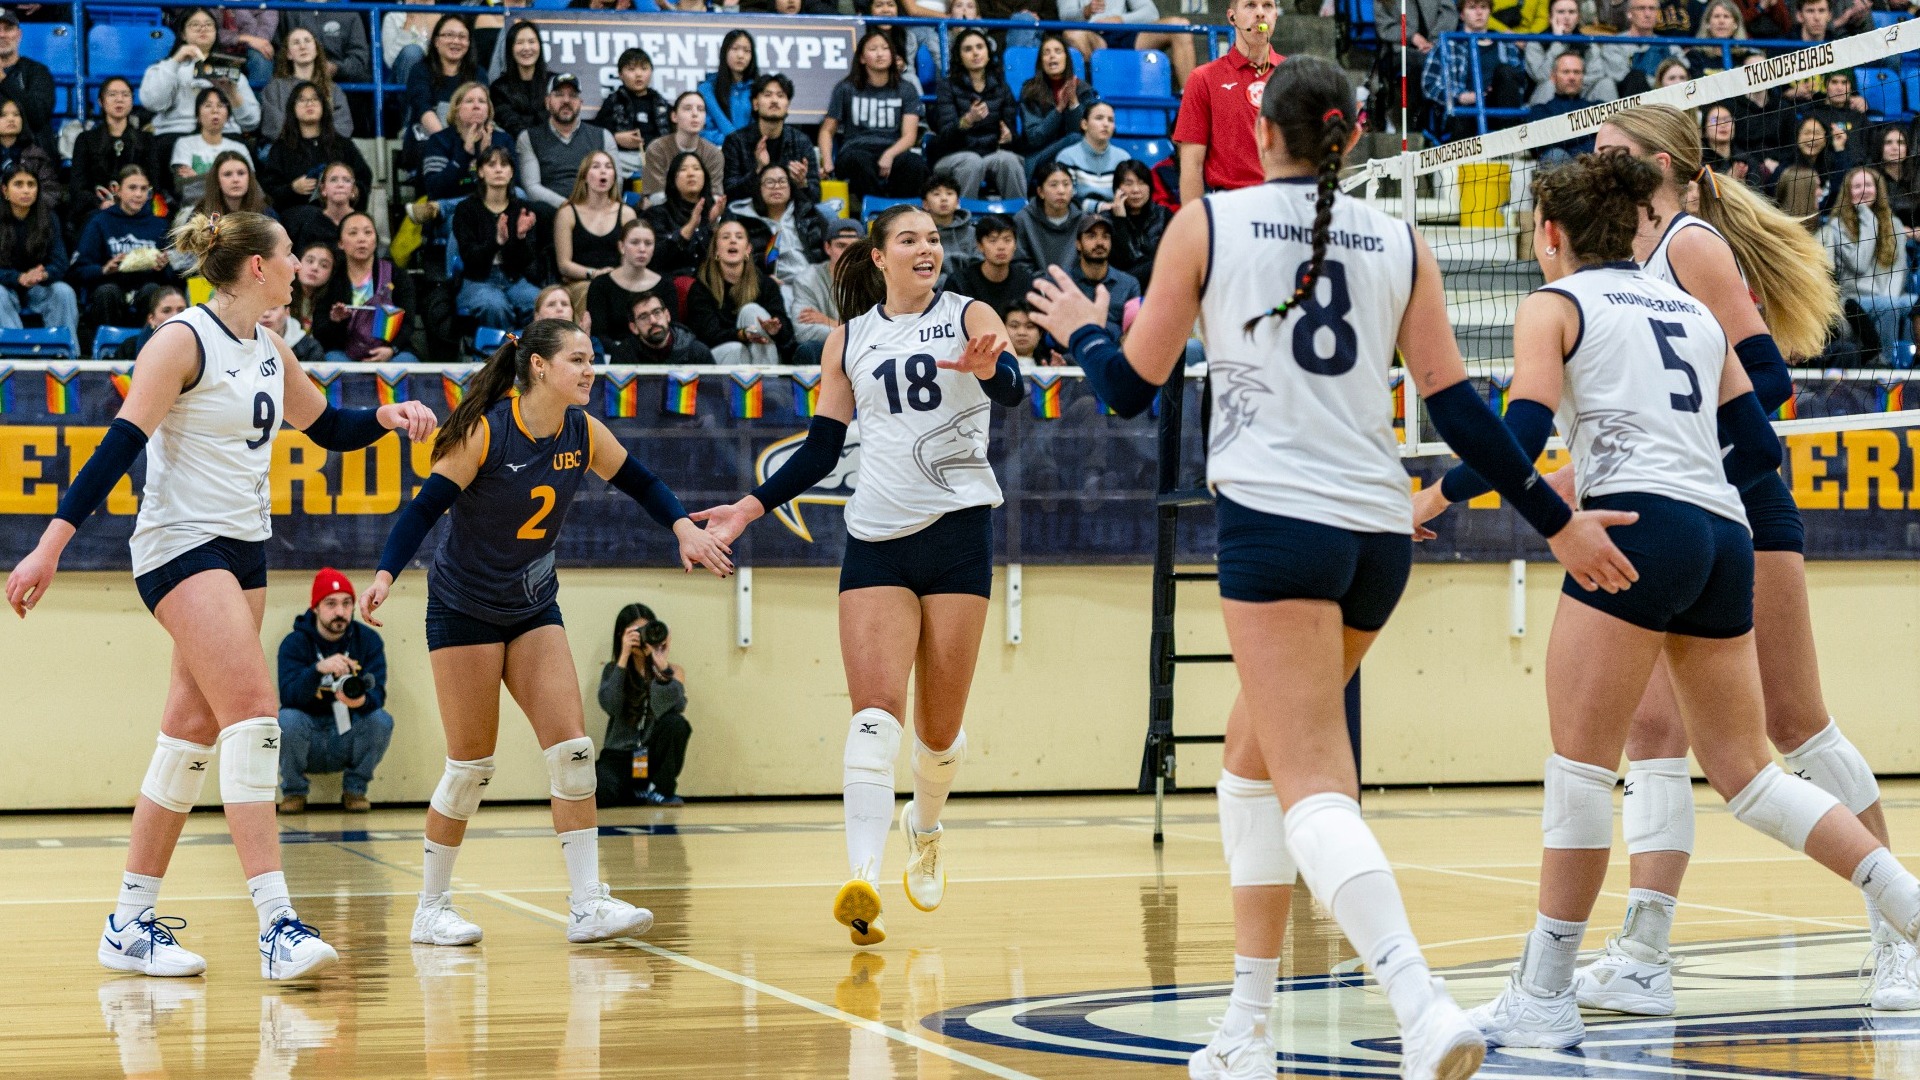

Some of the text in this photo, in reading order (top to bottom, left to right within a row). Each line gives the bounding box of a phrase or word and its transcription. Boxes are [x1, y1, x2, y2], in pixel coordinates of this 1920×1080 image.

[1744, 43, 1834, 86] THUNDERBIRDS
[852, 96, 902, 128] MIT
[1420, 137, 1482, 168] THUNDERBIRDS
[1292, 259, 1358, 377] 8
[1603, 292, 1702, 316] THUNDERBIRDS
[919, 323, 955, 343] UBC
[872, 353, 942, 415] 18
[1647, 317, 1703, 413] 5
[246, 391, 275, 450] 9
[553, 449, 581, 471] UBC
[516, 485, 556, 540] 2
